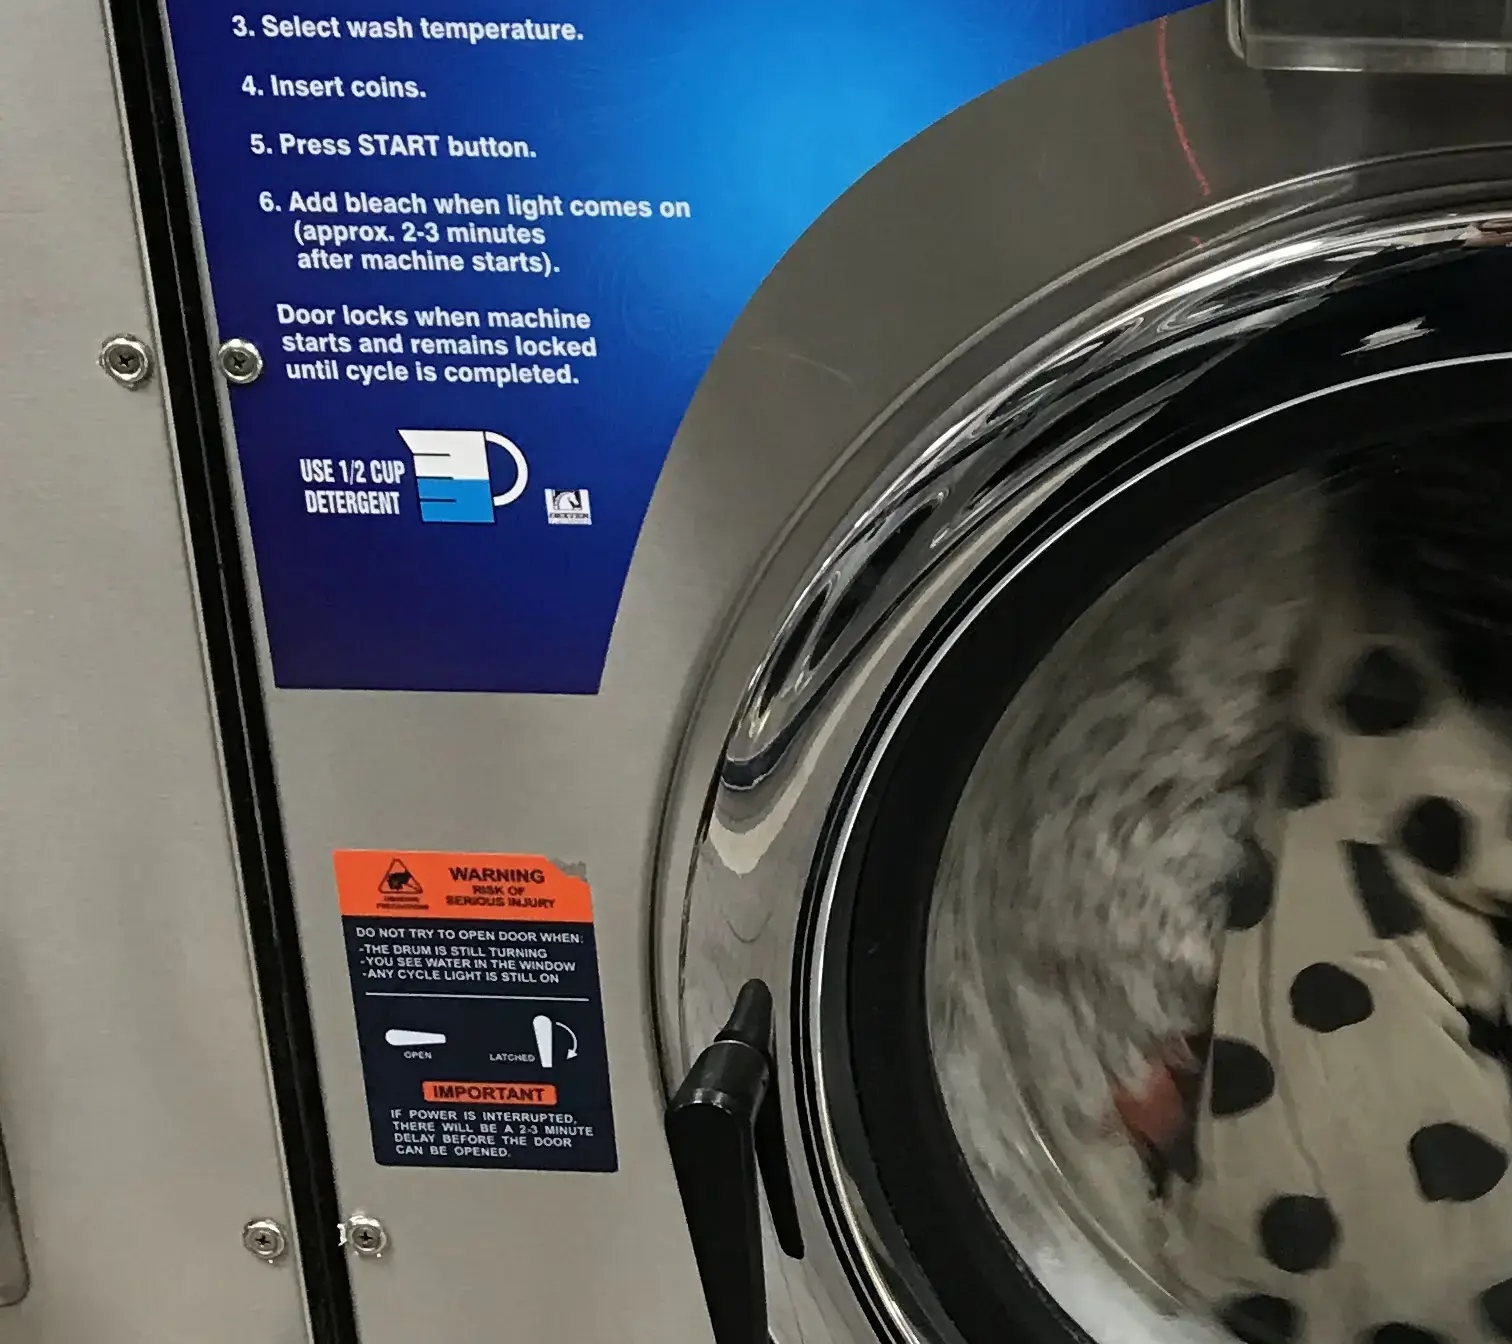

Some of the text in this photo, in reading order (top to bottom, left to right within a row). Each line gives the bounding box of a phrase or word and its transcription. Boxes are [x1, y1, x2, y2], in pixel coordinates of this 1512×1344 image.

[231, 14, 584, 45] 3. Select wash temperature.
[241, 74, 427, 99] 4. Insert coins.
[250, 133, 537, 158] 5. Press START button.
[259, 190, 692, 221] 6. Add bleach when light comes on
[294, 219, 546, 247] (approx. 2-3 minutes
[297, 248, 561, 278] after machine starts).
[276, 303, 591, 330] Door locks when machine
[282, 332, 598, 357] starts and remains locked
[285, 359, 580, 389] until cycle is completed.
[299, 458, 406, 486] USE 1/2 CUP
[304, 489, 400, 515] DETERGENT
[448, 866, 546, 885] WARNING
[355, 927, 376, 938] DO
[378, 927, 406, 939] NOT
[408, 928, 434, 939] TRY
[436, 929, 456, 940] TO
[458, 929, 496, 941] OPEN
[498, 931, 538, 942] DOOR
[403, 1050, 433, 1060] OPEN
[489, 1052, 536, 1063] LATCHED
[432, 1085, 546, 1102] IMPORTANT
